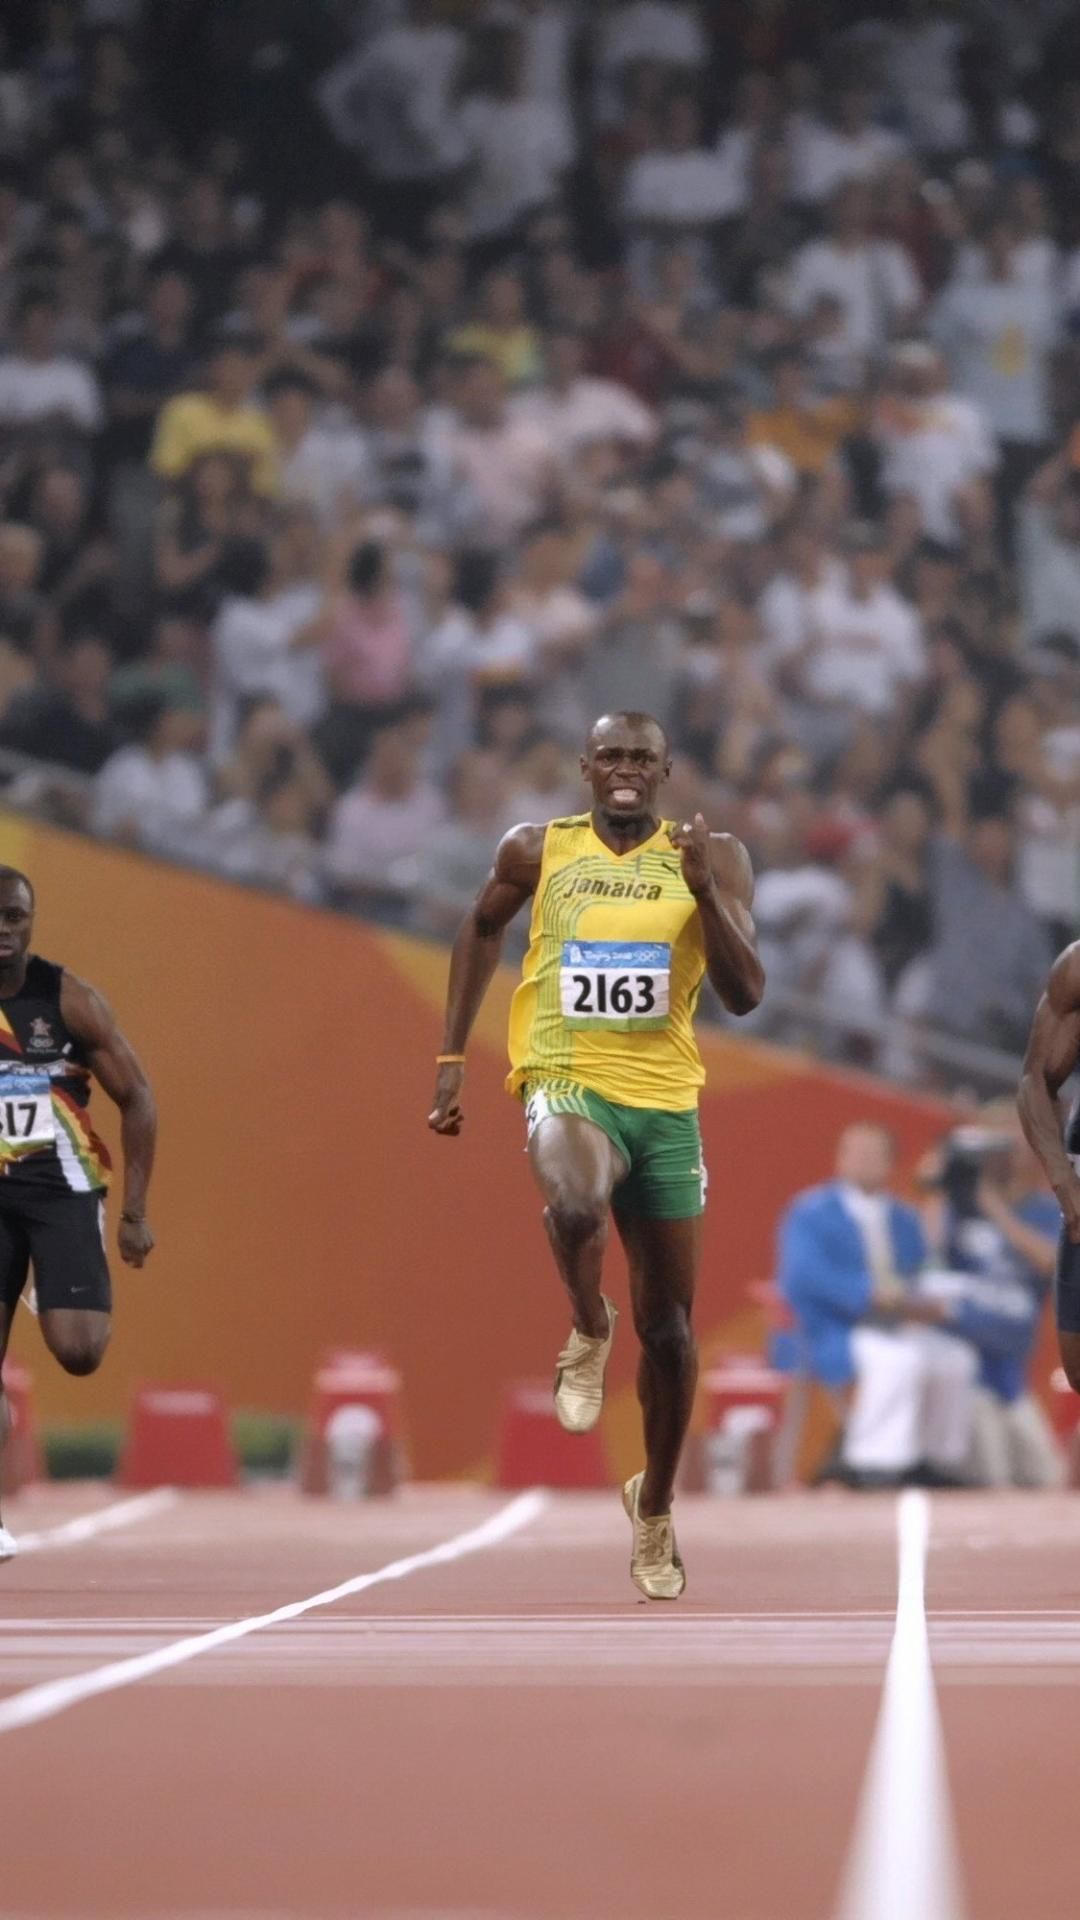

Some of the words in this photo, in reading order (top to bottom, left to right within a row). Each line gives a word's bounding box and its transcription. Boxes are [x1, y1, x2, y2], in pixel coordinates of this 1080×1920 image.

[563, 872, 662, 901] jamaica
[572, 974, 656, 1014] 2163
[0, 1101, 37, 1137] 17
